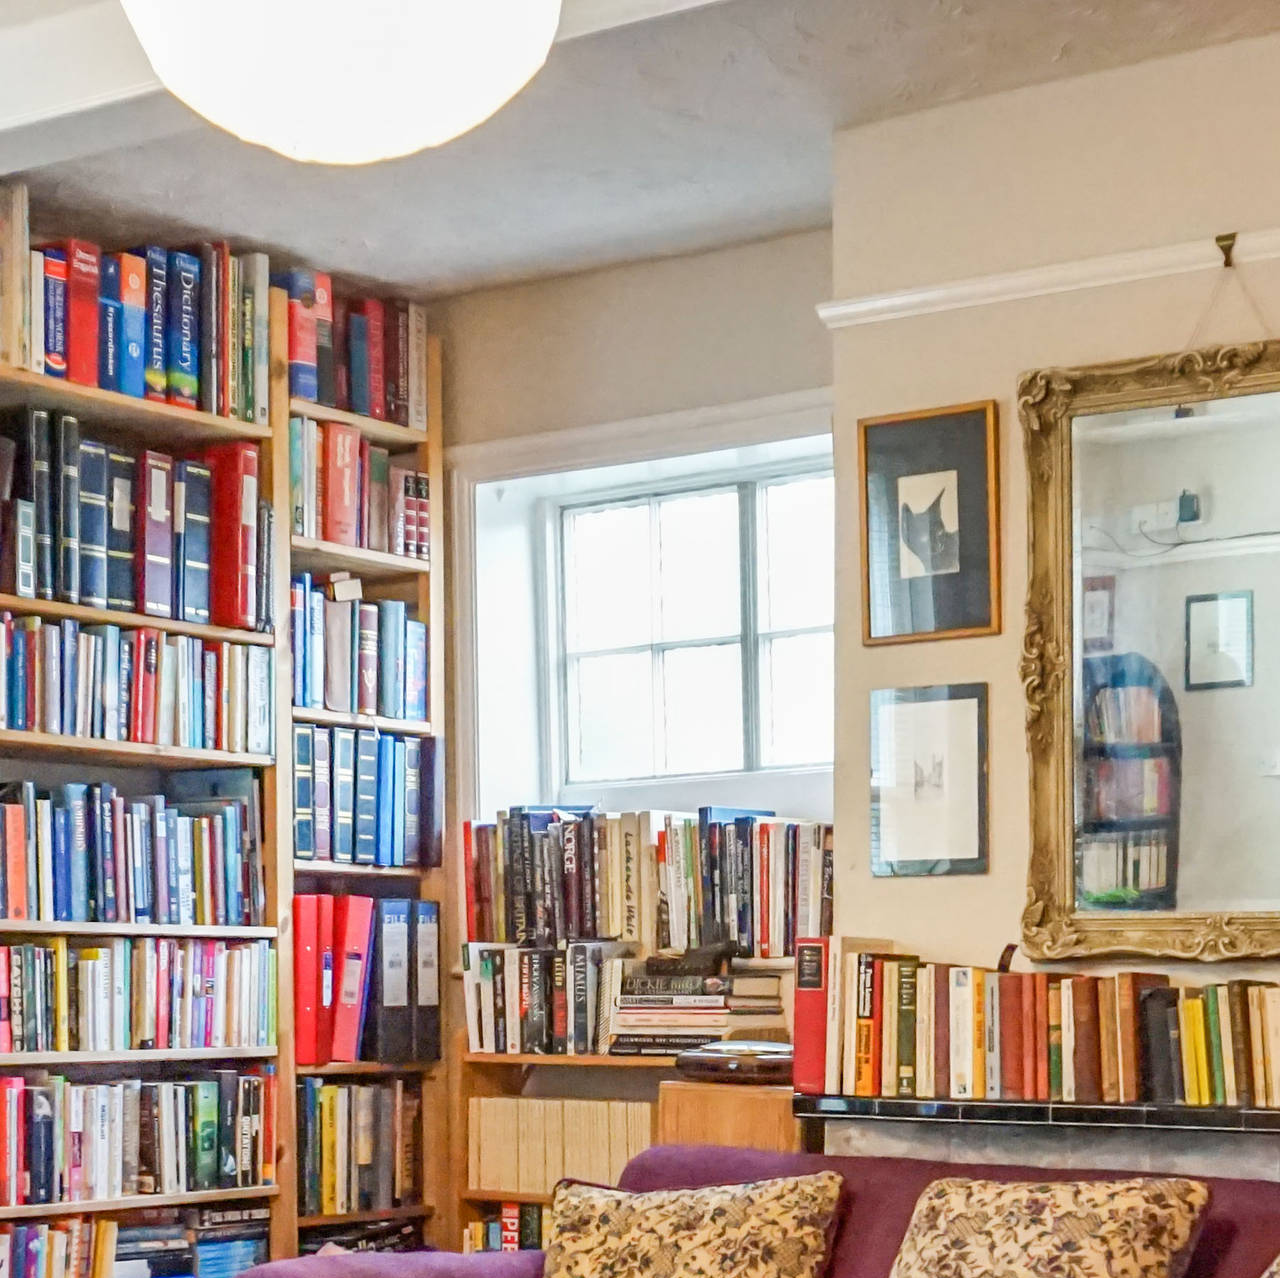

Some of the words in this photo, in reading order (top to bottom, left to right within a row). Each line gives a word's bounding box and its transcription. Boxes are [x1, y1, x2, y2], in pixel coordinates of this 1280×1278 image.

[152, 265, 167, 369] Thesaurus
[178, 271, 195, 371] Dictionary
[564, 824, 576, 873] NORGE
[242, 1116, 250, 1171] QUOTATIONS
